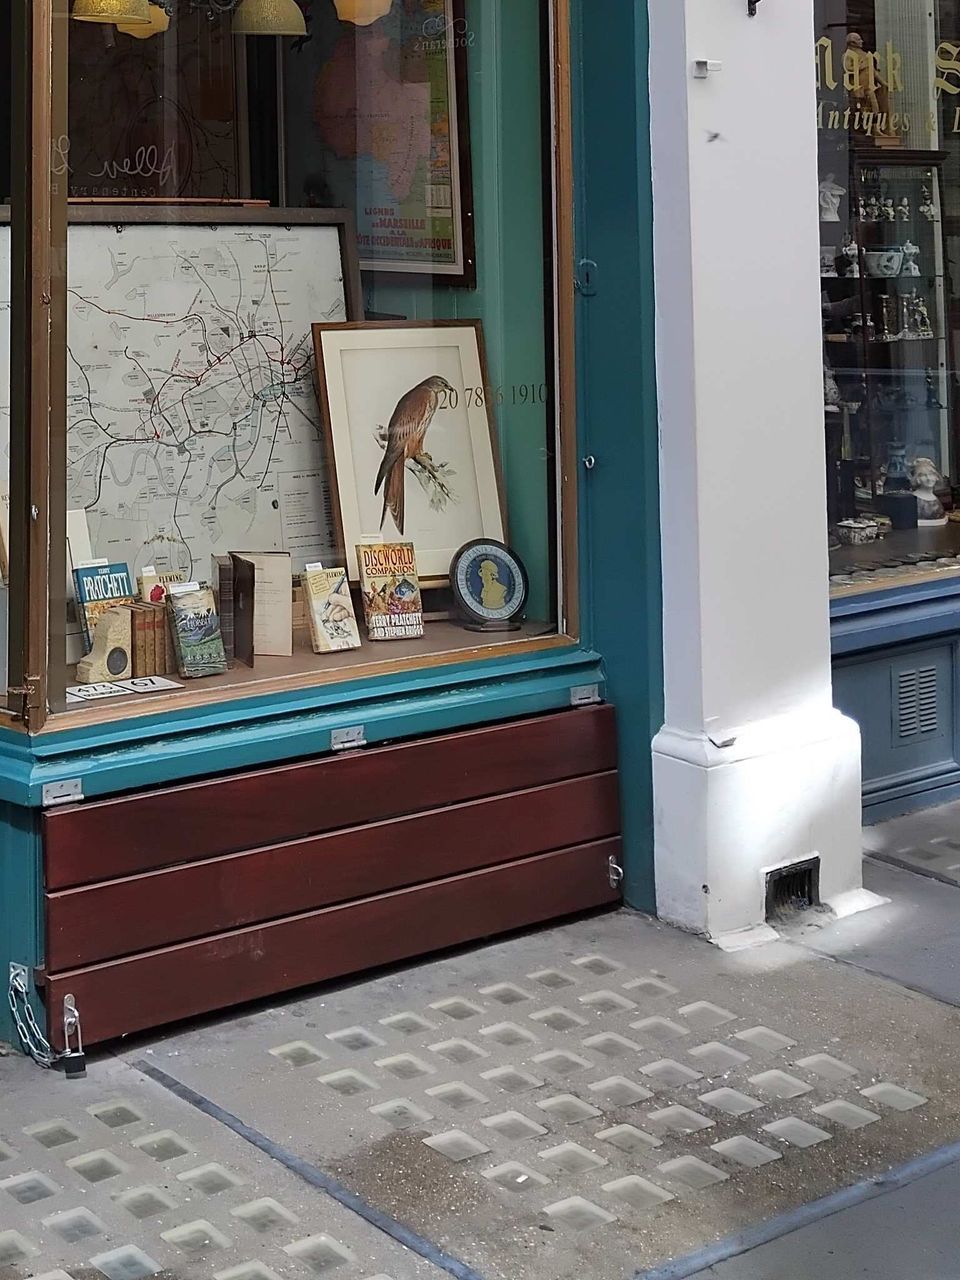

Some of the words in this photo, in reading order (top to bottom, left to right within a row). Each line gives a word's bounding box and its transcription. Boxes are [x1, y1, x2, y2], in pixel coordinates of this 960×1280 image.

[465, 385, 503, 408] 786
[363, 548, 414, 567] DISCWORLD
[365, 565, 415, 576] COMPANION
[159, 573, 183, 583] FLEMING
[82, 573, 129, 601] PRATCHETT
[372, 615, 391, 627] TERRY
[391, 613, 422, 626] PRATCHETT
[374, 627, 385, 637] AND
[385, 626, 406, 637] STEPHEN
